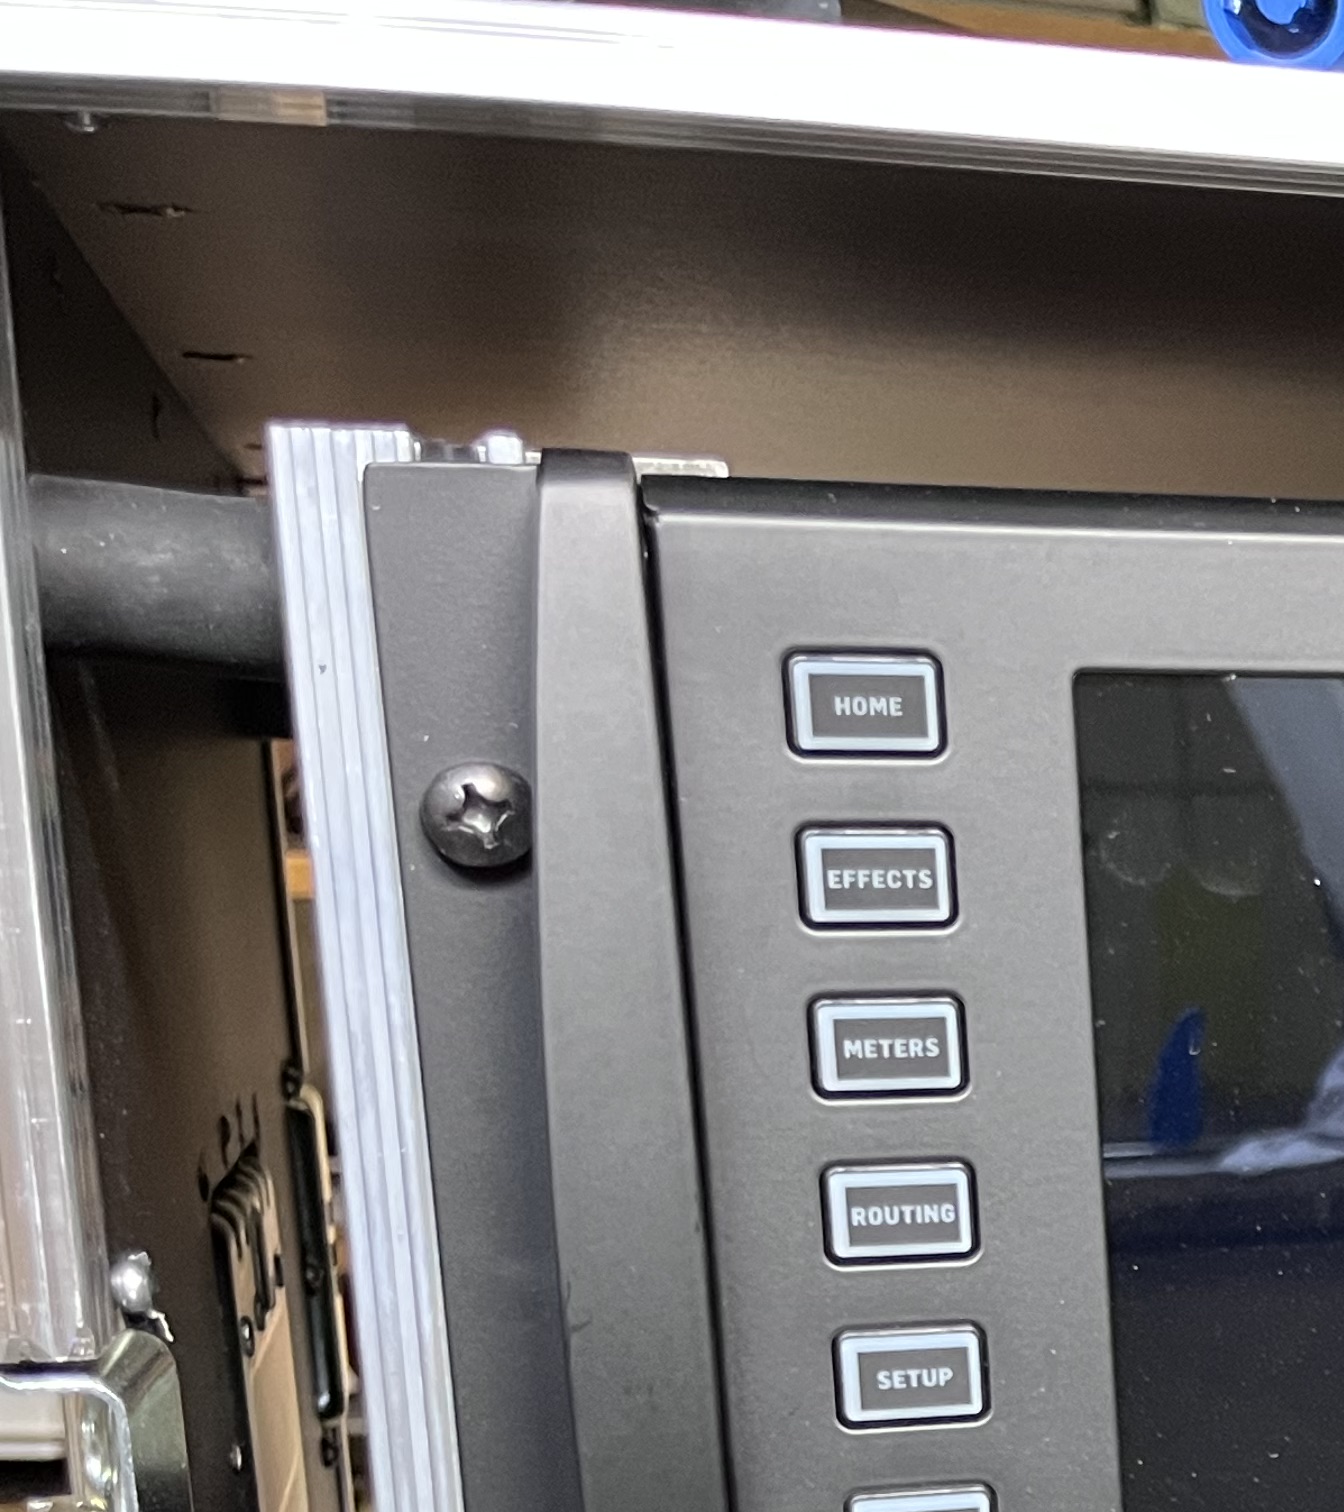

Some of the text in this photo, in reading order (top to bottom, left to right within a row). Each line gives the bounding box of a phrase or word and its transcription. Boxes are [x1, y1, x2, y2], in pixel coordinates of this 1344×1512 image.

[834, 696, 903, 717] HOME
[826, 868, 934, 890] EFFECTS
[843, 1037, 940, 1059] METERS
[851, 1203, 956, 1227] ROUTING
[877, 1367, 954, 1390] SETUP
